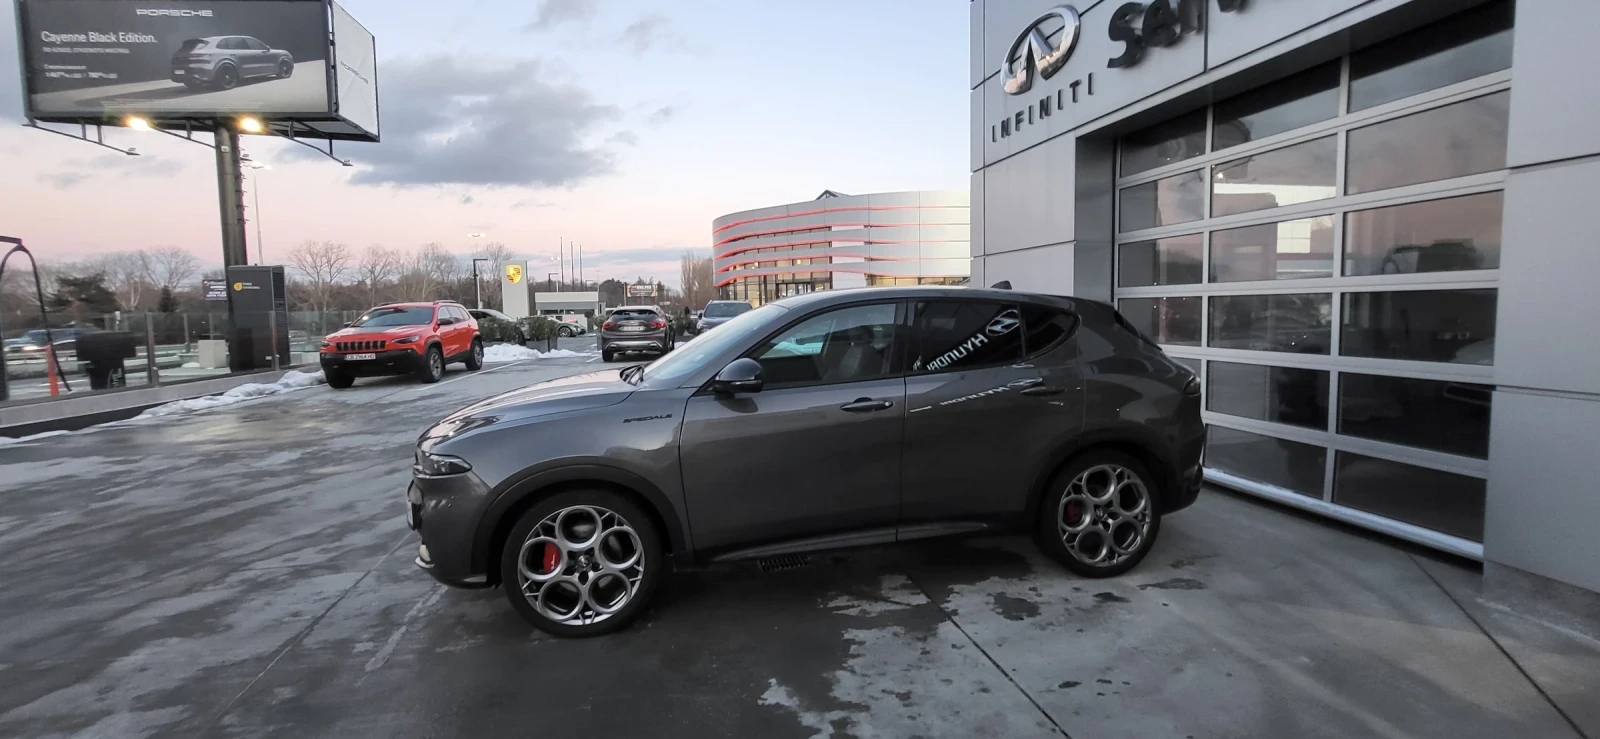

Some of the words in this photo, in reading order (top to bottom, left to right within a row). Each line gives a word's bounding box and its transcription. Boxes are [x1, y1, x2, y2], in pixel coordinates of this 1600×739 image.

[136, 9, 213, 17] PORSCHE
[41, 31, 86, 45] Cayenne
[88, 32, 117, 43] Black
[119, 33, 157, 43] Edition.
[992, 72, 1095, 142] INFINITI
